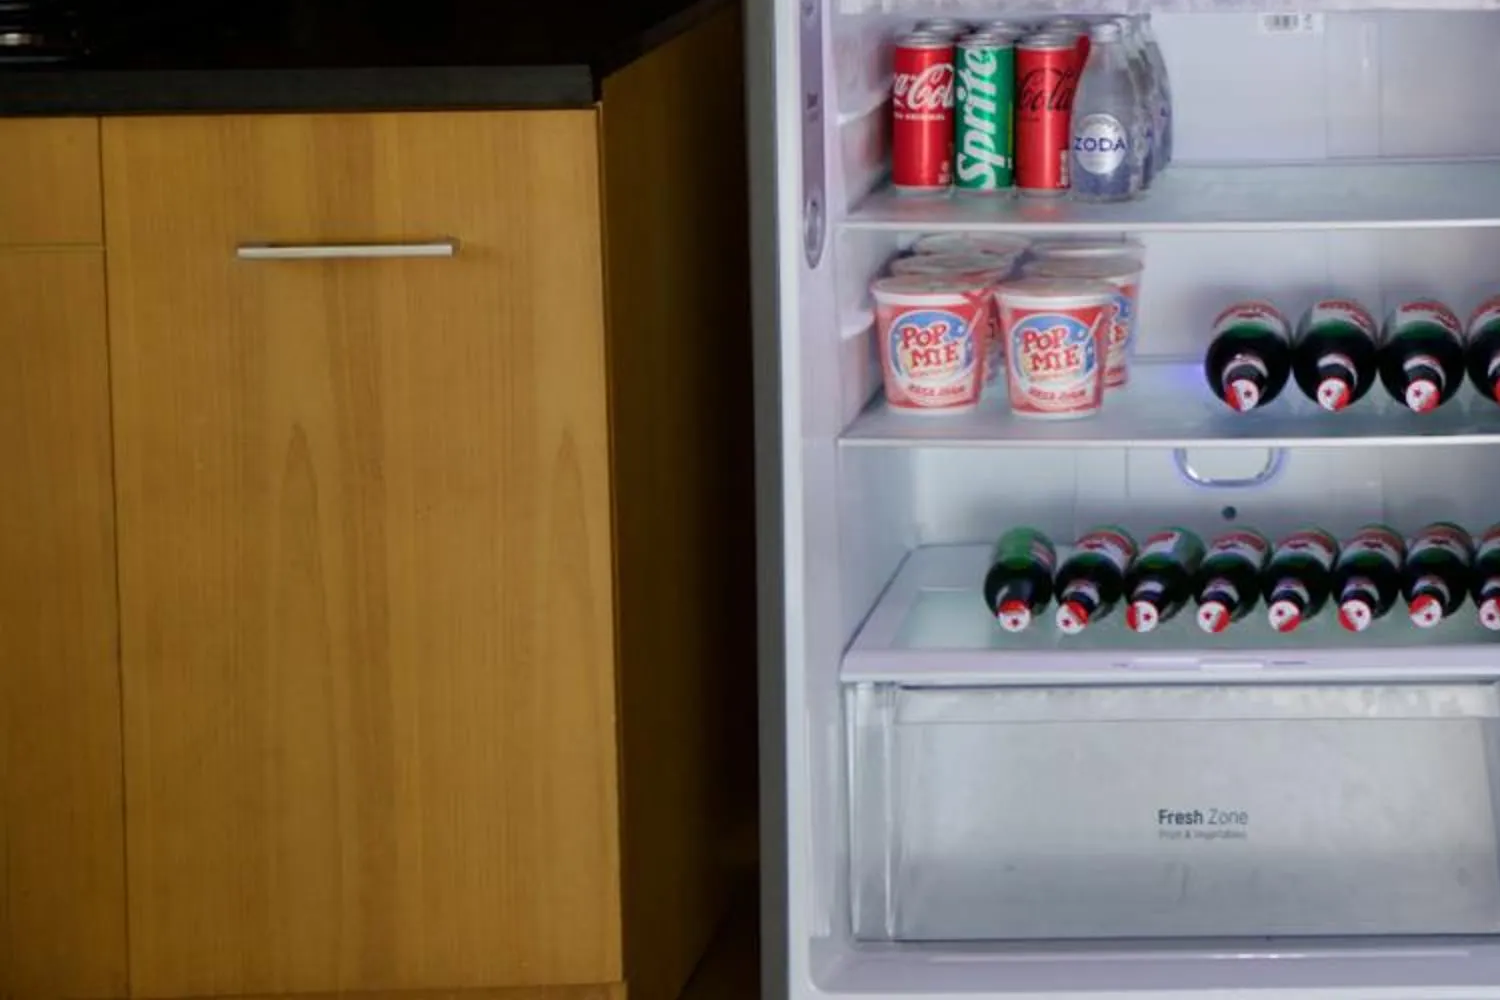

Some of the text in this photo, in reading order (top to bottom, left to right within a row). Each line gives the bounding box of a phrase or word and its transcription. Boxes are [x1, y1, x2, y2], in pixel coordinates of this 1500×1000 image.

[957, 47, 1005, 192] Sprite
[1074, 136, 1126, 152] ZODA
[903, 324, 947, 349] POP
[1023, 328, 1067, 354] POP
[1158, 807, 1248, 825] Fresh Zone
